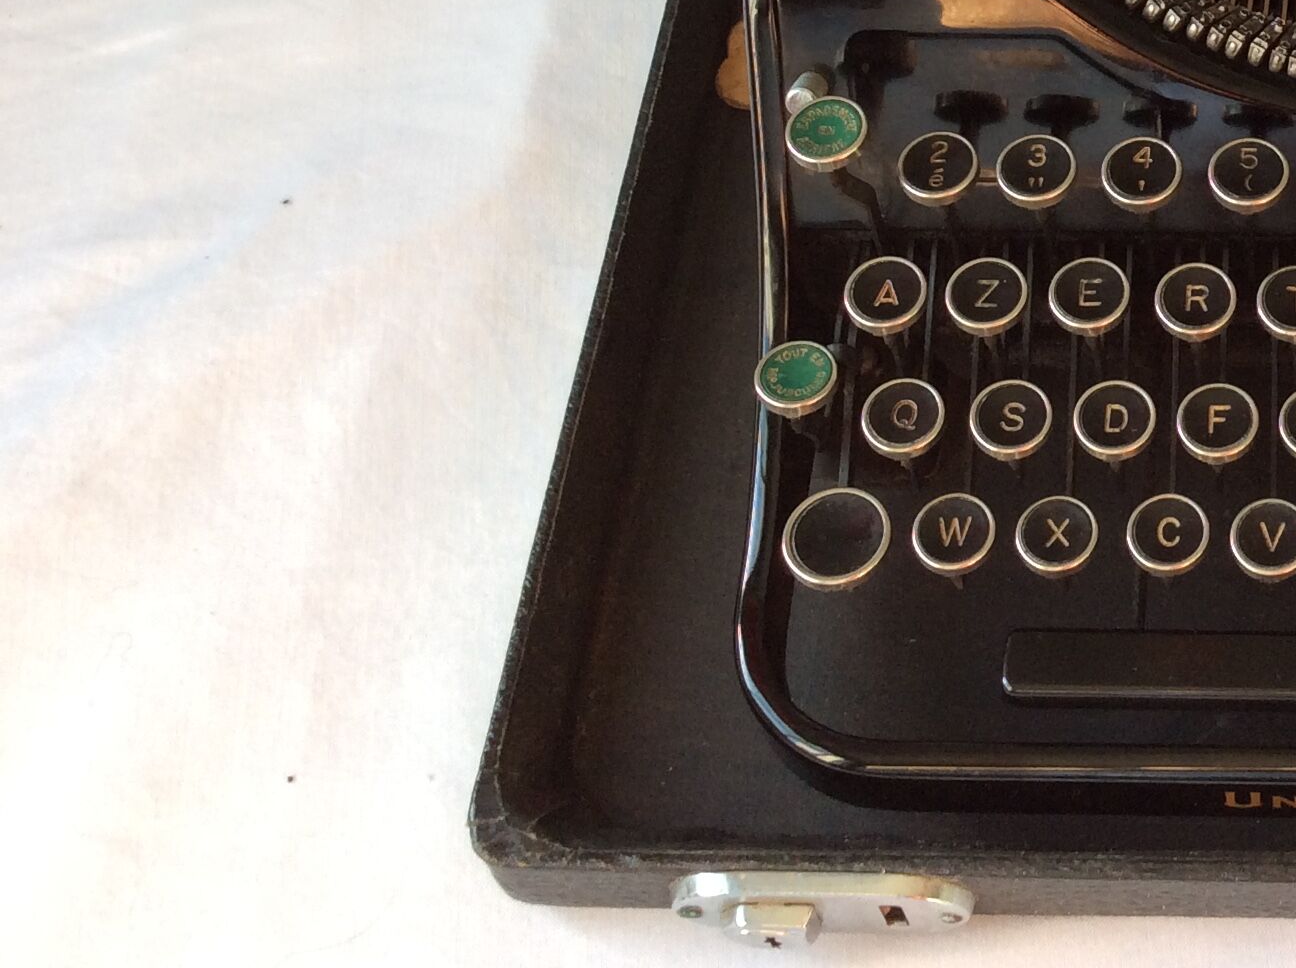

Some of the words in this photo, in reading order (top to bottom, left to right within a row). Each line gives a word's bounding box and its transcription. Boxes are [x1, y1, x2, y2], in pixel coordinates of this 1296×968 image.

[931, 140, 948, 164] 2
[1028, 143, 1047, 168] 3
[1132, 146, 1153, 169] 4
[1240, 147, 1258, 169] 5
[875, 279, 899, 307] A
[974, 279, 1000, 308] Z
[1078, 278, 1103, 307] E
[1185, 284, 1209, 312] R
[892, 398, 918, 431] Q
[1000, 401, 1027, 432] S
[1104, 403, 1129, 433] D
[1208, 404, 1232, 435] F
[938, 515, 973, 548] W
[1045, 518, 1071, 548] X
[1156, 516, 1182, 548] C
[1259, 521, 1286, 552] V
